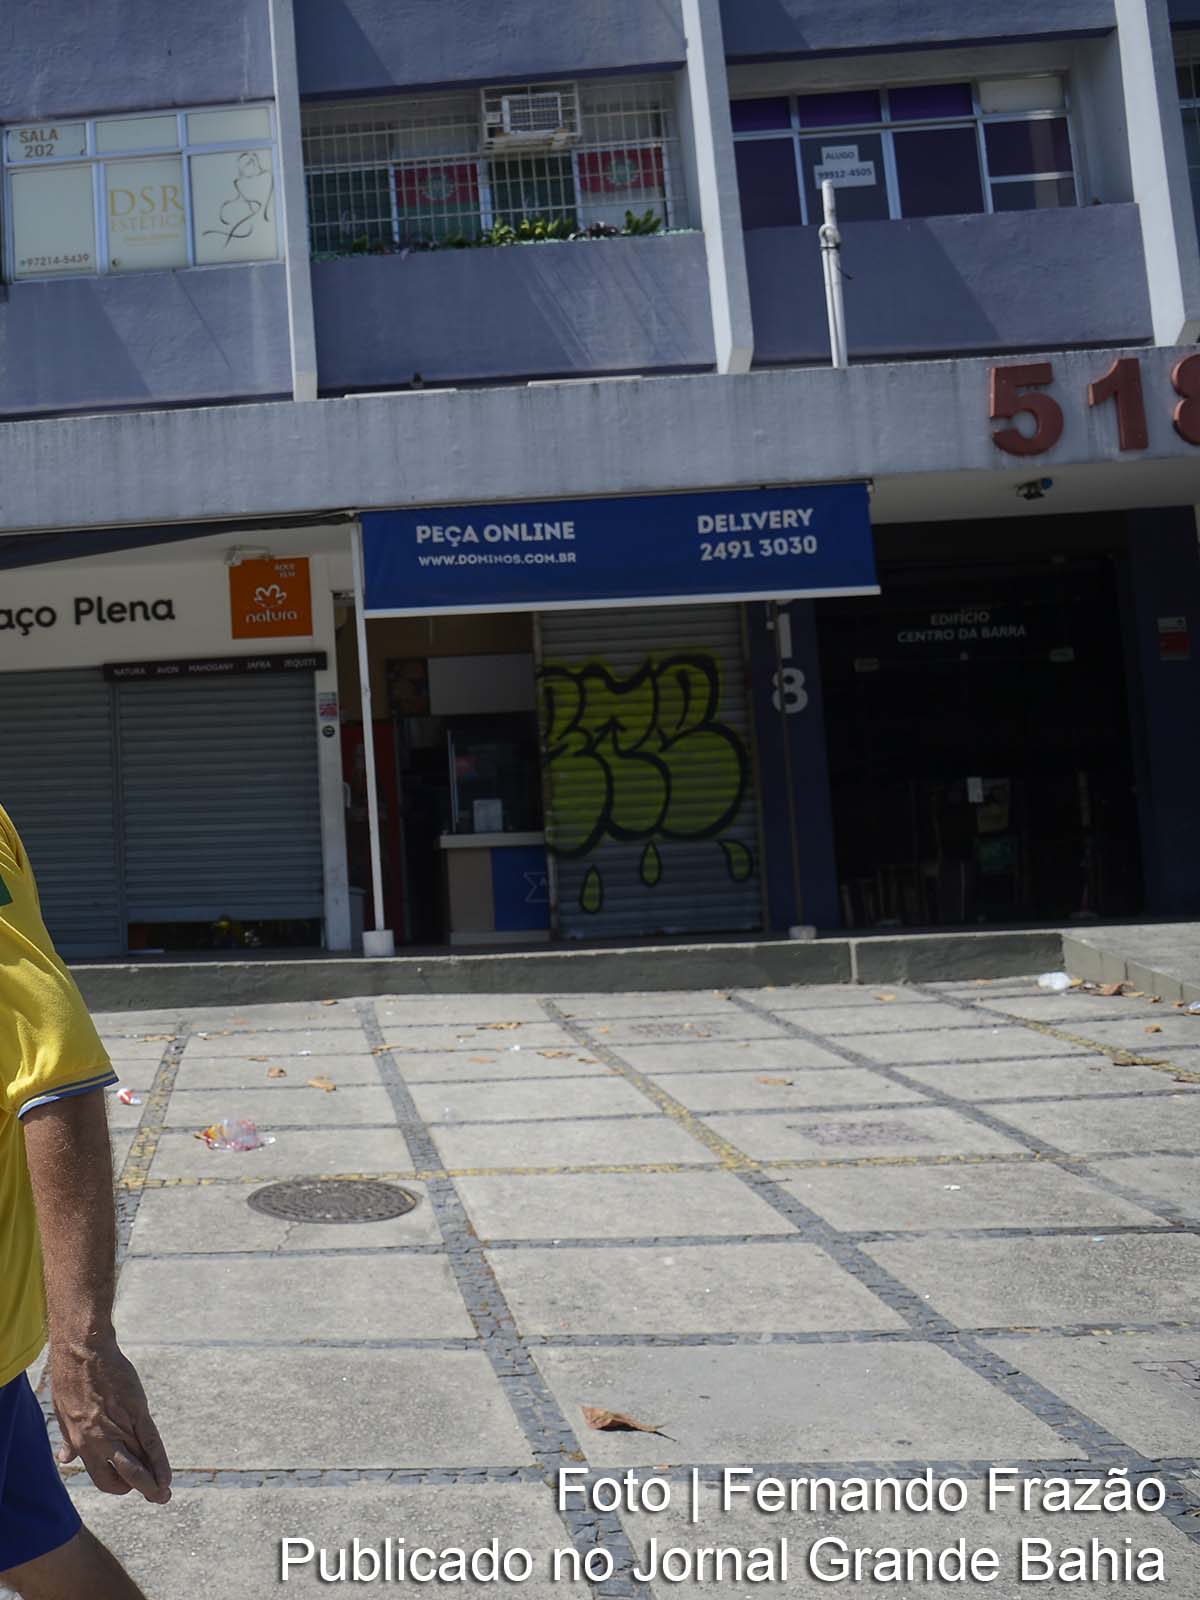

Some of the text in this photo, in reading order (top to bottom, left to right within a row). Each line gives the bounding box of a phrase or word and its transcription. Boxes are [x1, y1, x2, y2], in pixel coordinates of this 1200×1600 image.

[19, 128, 59, 143] SALA
[24, 143, 55, 158] 202
[109, 184, 184, 216] DSR
[697, 508, 814, 534] DELIVERY
[416, 521, 576, 547] PEÇA ONLINE
[699, 535, 817, 561] 2491 3030
[418, 552, 577, 567] WWW.DOMINOS.COM.BR
[73, 596, 176, 625] Plena
[245, 609, 298, 624] natura
[897, 629, 955, 643] CENTRO
[958, 627, 978, 641] DA
[113, 666, 146, 677] NATURA
